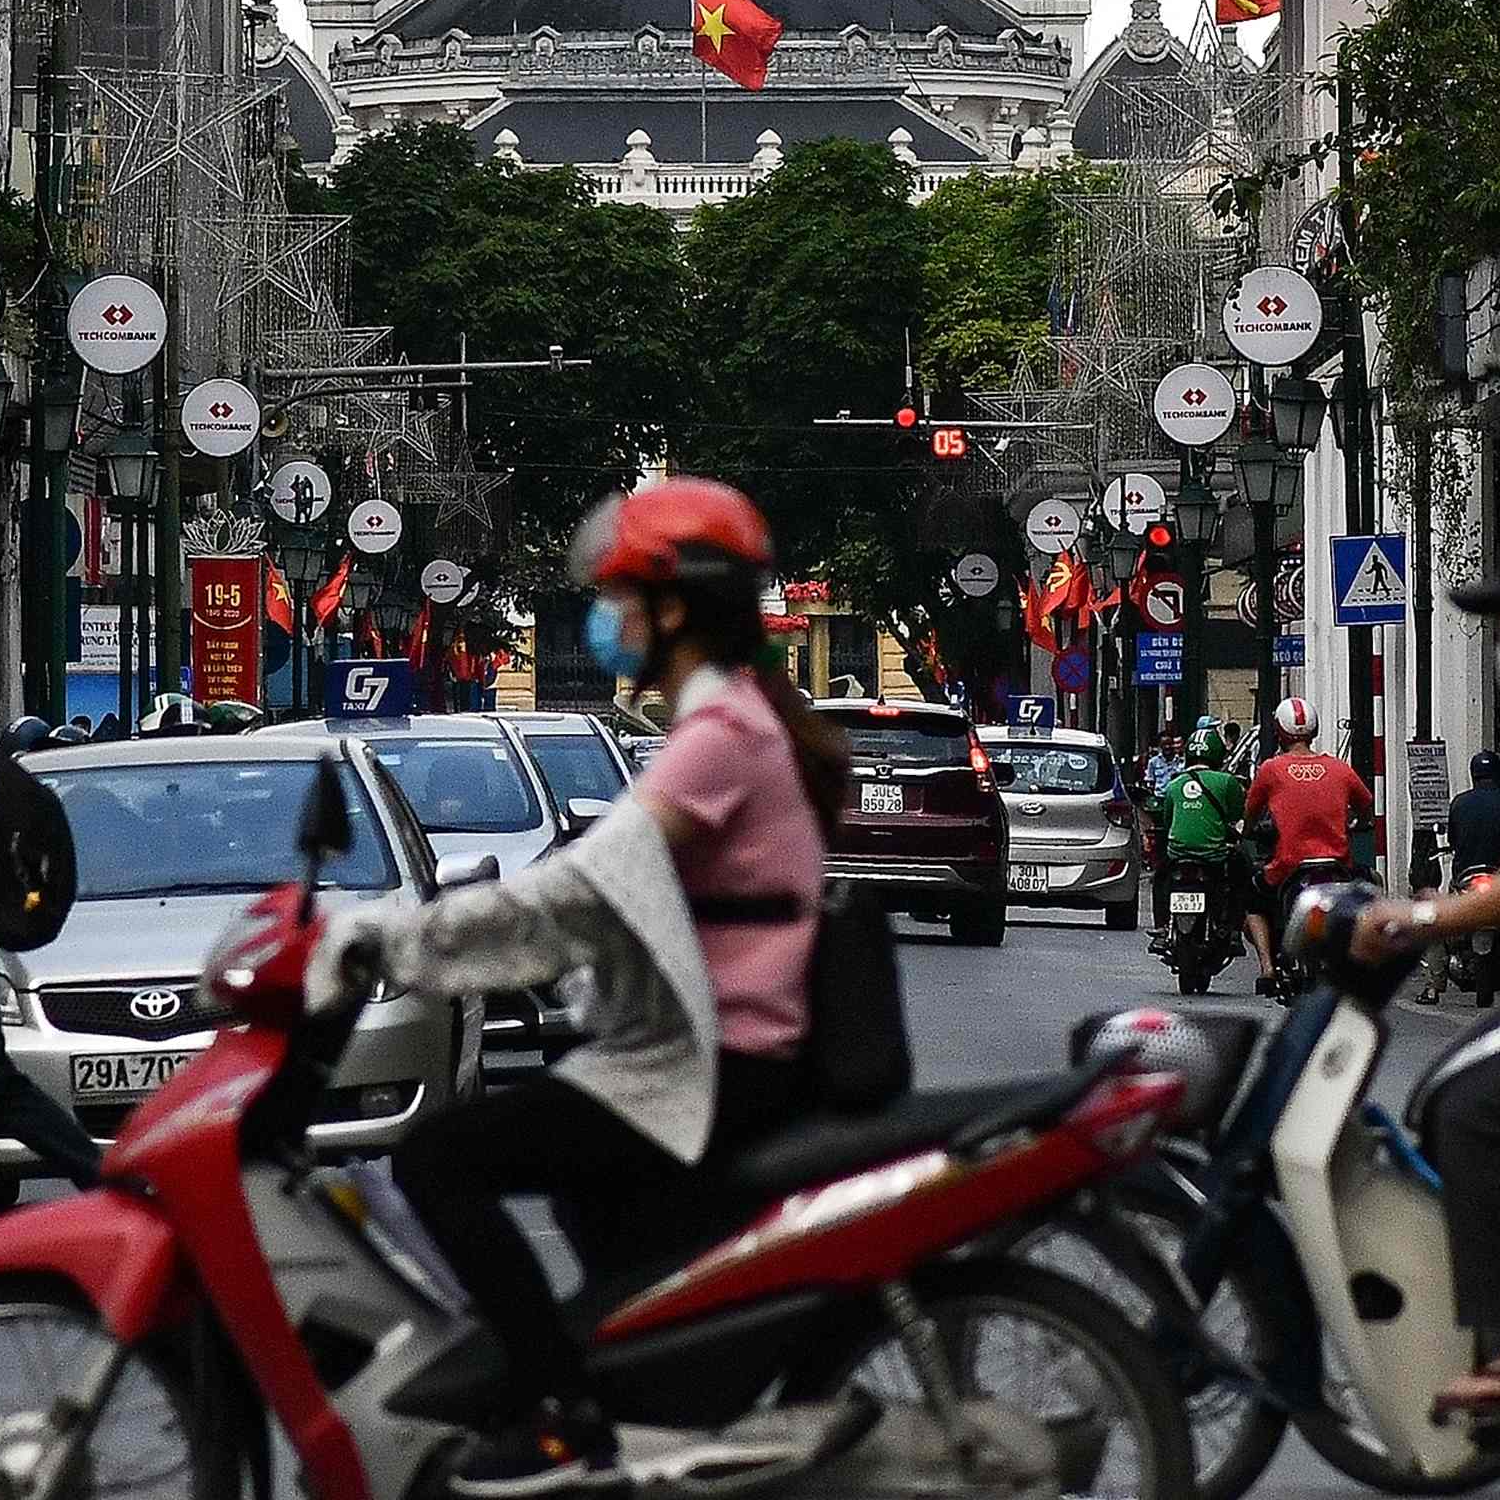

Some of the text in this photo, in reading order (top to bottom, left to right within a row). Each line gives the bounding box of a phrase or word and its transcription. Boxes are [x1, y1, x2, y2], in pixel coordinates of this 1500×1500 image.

[1234, 322, 1312, 333] TECHCOMBANK
[77, 331, 158, 341] TECHCOMBANK
[1162, 411, 1228, 420] TECHCOMBANK
[189, 422, 253, 432] TECHCOMBANK
[933, 430, 965, 455] 05
[205, 583, 241, 607] 19-5
[345, 667, 389, 711] G7
[342, 702, 365, 711] TAXI
[1019, 699, 1043, 724] G7
[1017, 865, 1039, 877] 30A
